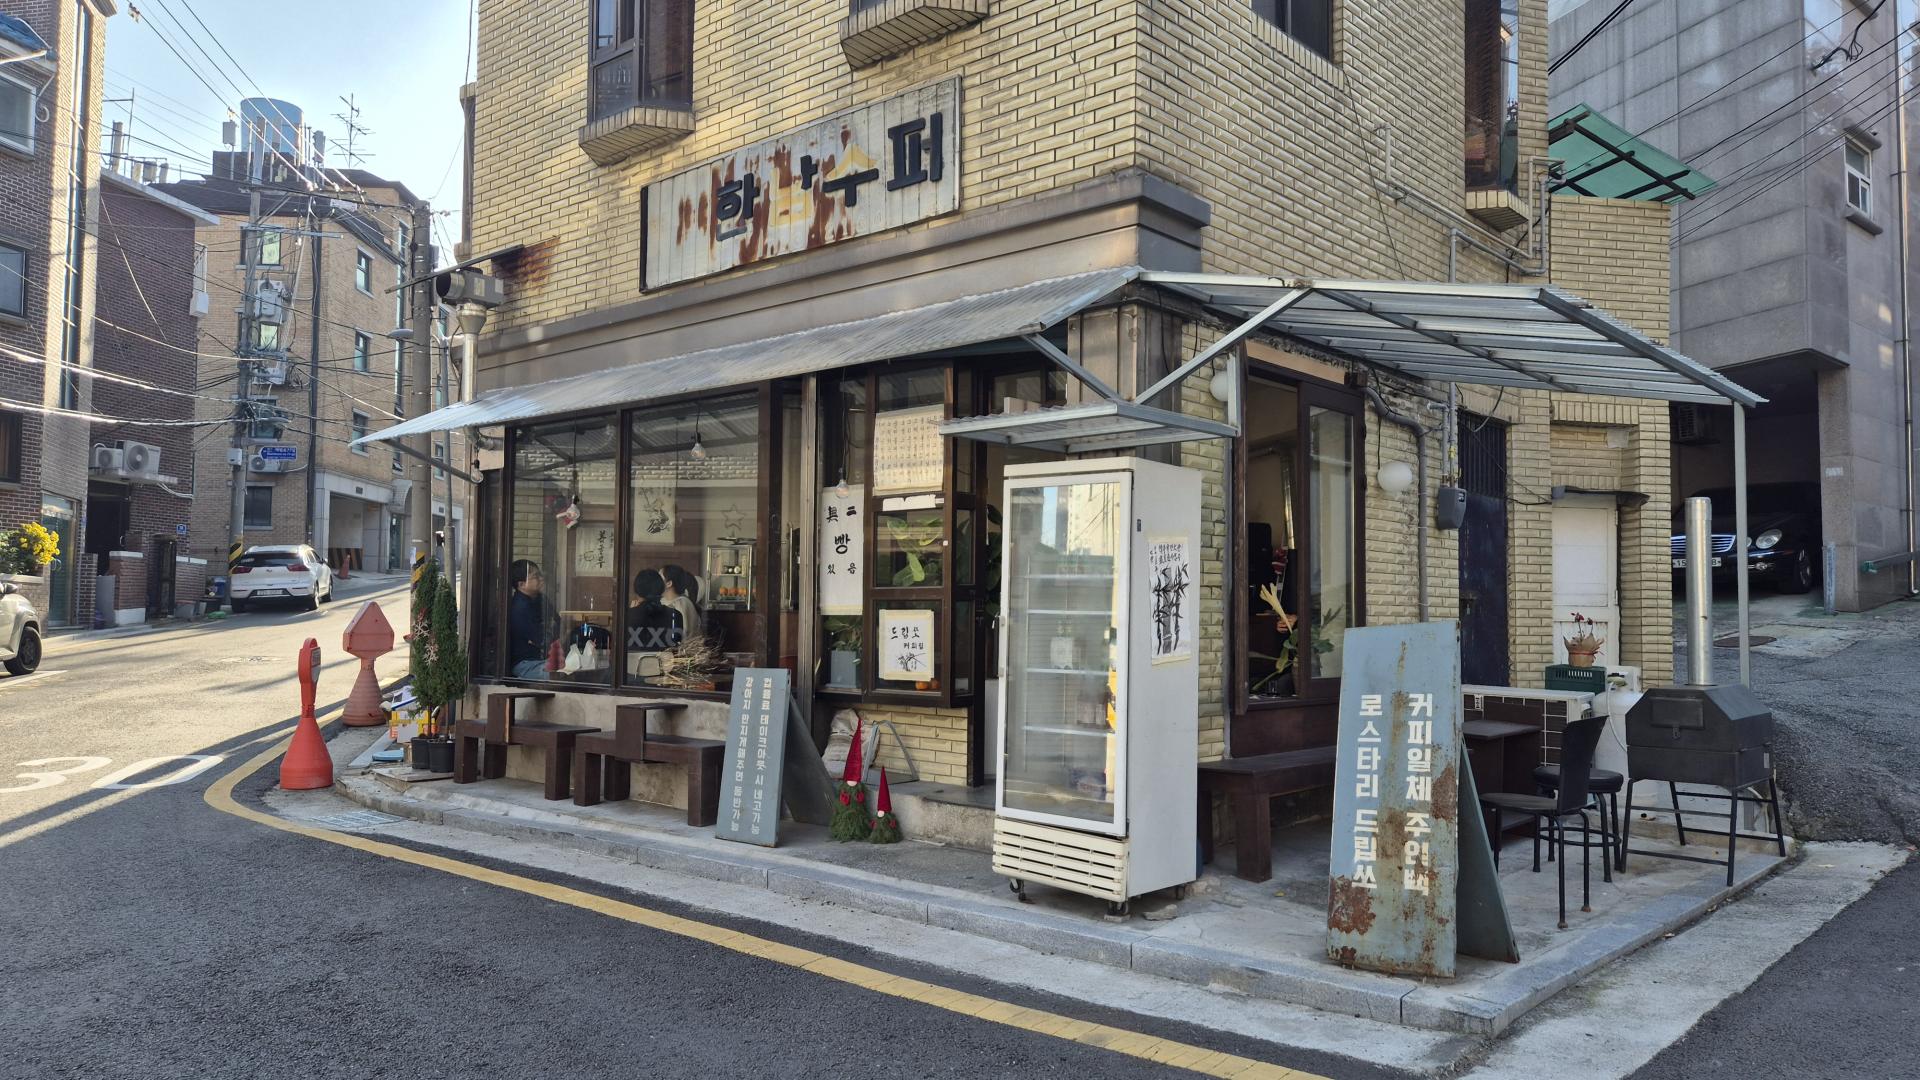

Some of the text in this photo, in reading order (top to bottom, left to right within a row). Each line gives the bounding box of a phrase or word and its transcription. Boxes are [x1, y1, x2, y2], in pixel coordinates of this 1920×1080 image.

[834, 533, 851, 555] 빵
[742, 676, 754, 711] 강아지
[756, 714, 769, 771] 테이크아웃
[1355, 693, 1384, 799] 로스타리
[0, 754, 225, 793] 30
[1403, 692, 1434, 897] 커피일체 주인백
[730, 785, 742, 832] 동반가능
